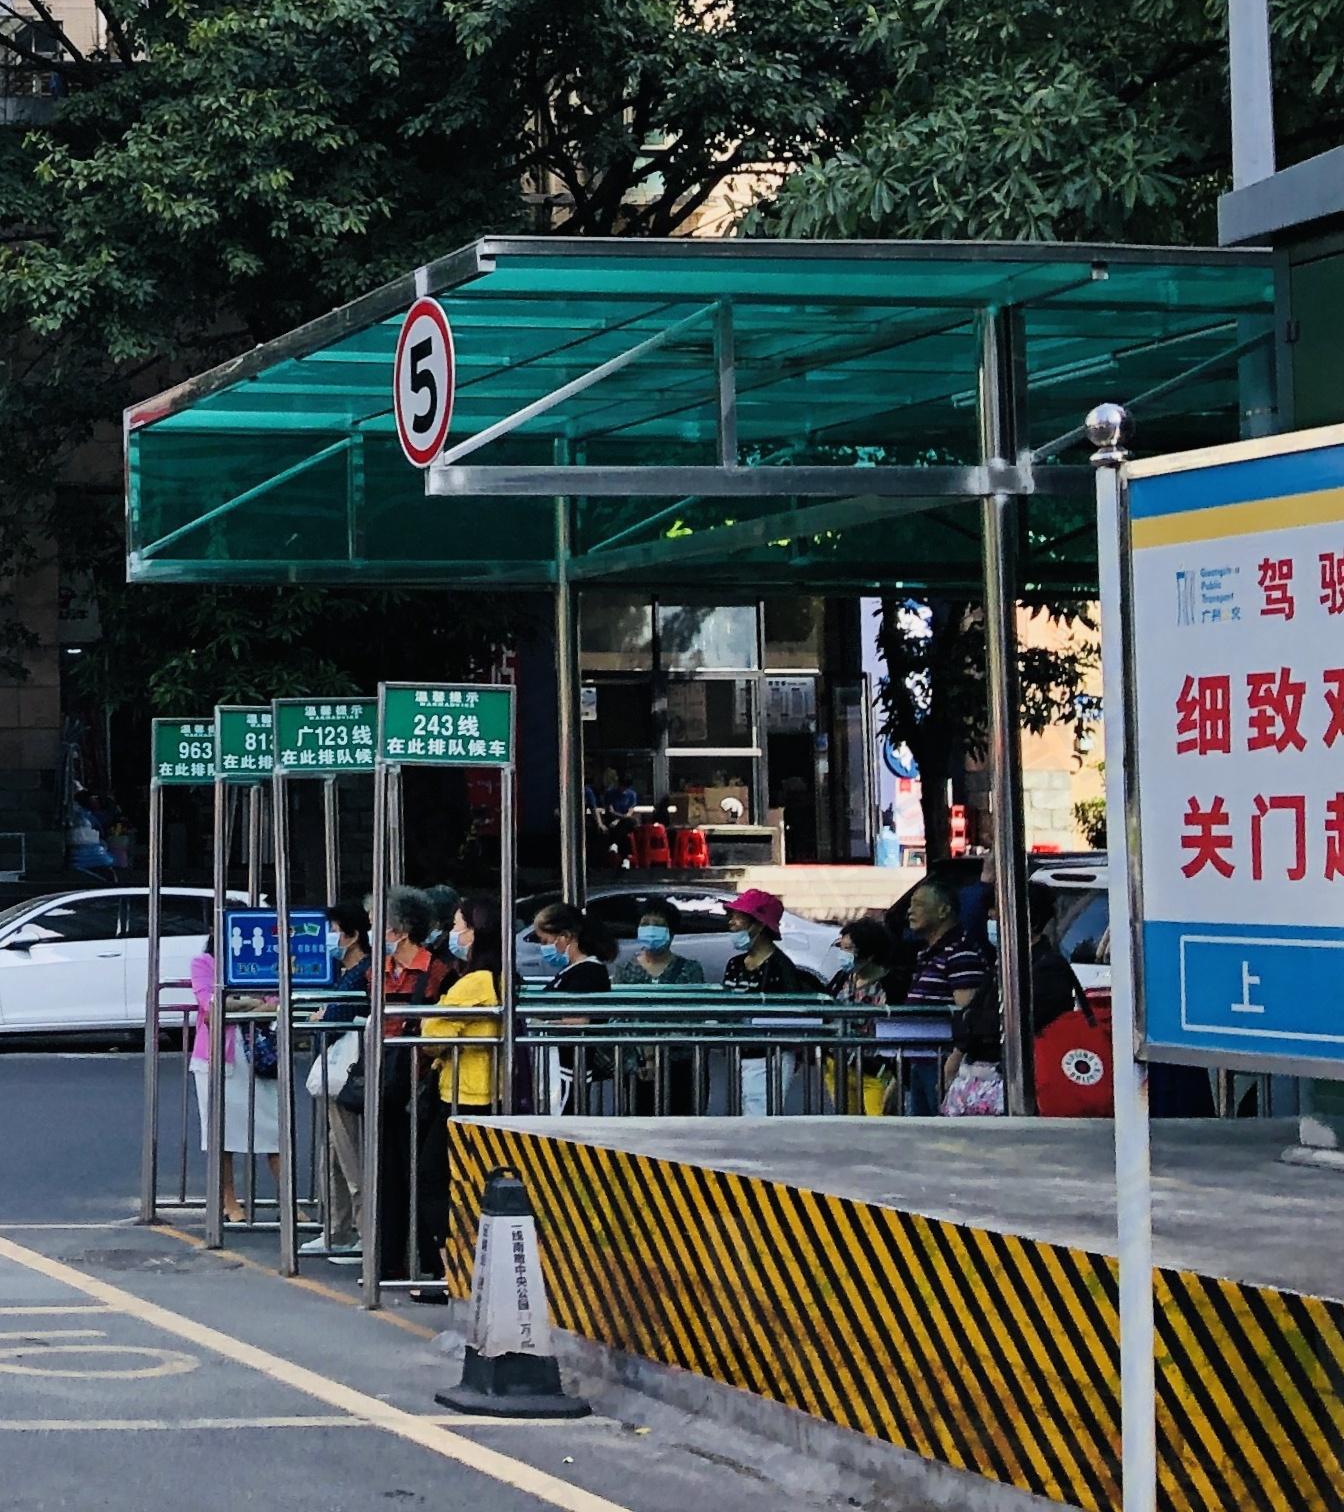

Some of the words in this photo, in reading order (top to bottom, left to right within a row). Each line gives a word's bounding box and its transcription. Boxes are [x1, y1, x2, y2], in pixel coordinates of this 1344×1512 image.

[410, 335, 438, 435] 5
[1257, 551, 1344, 622] 驾驶
[178, 741, 213, 759] 963
[386, 737, 507, 758] 在此排队候车
[1230, 960, 1265, 1014] 上
